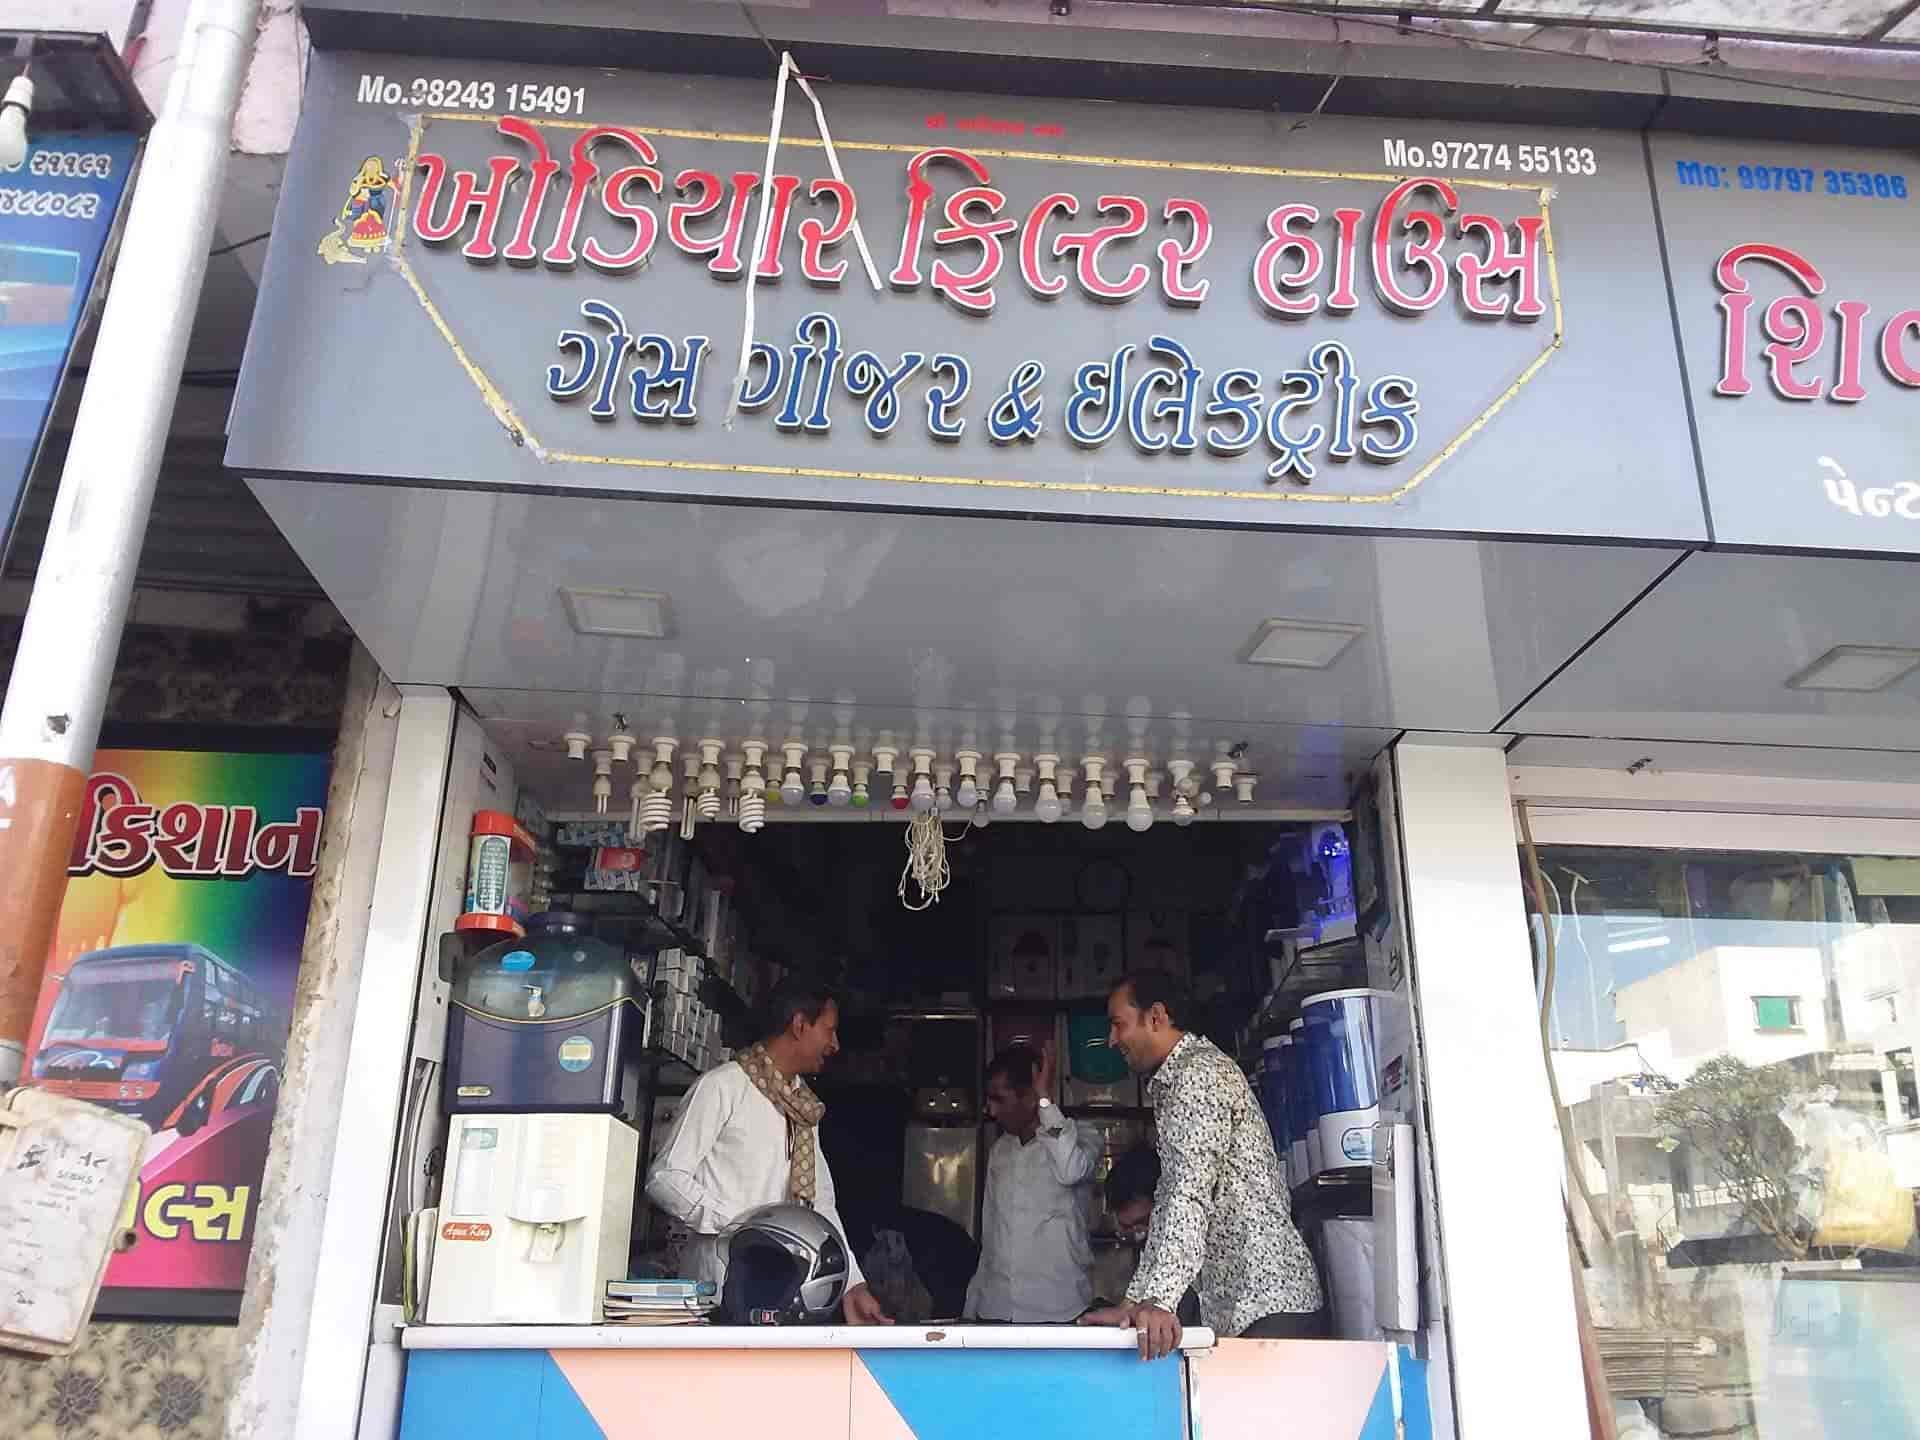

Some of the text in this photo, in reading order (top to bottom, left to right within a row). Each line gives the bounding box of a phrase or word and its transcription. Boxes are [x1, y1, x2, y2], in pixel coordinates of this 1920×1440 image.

[505, 83, 586, 114] 15491
[1383, 138, 1598, 176] Mo.97274 55133
[412, 115, 1547, 317] ખોડિયાર ફિલ્ટર હાઉસ
[546, 300, 711, 418] ગેસ
[736, 312, 972, 438] ગીજર
[987, 359, 1045, 441] &
